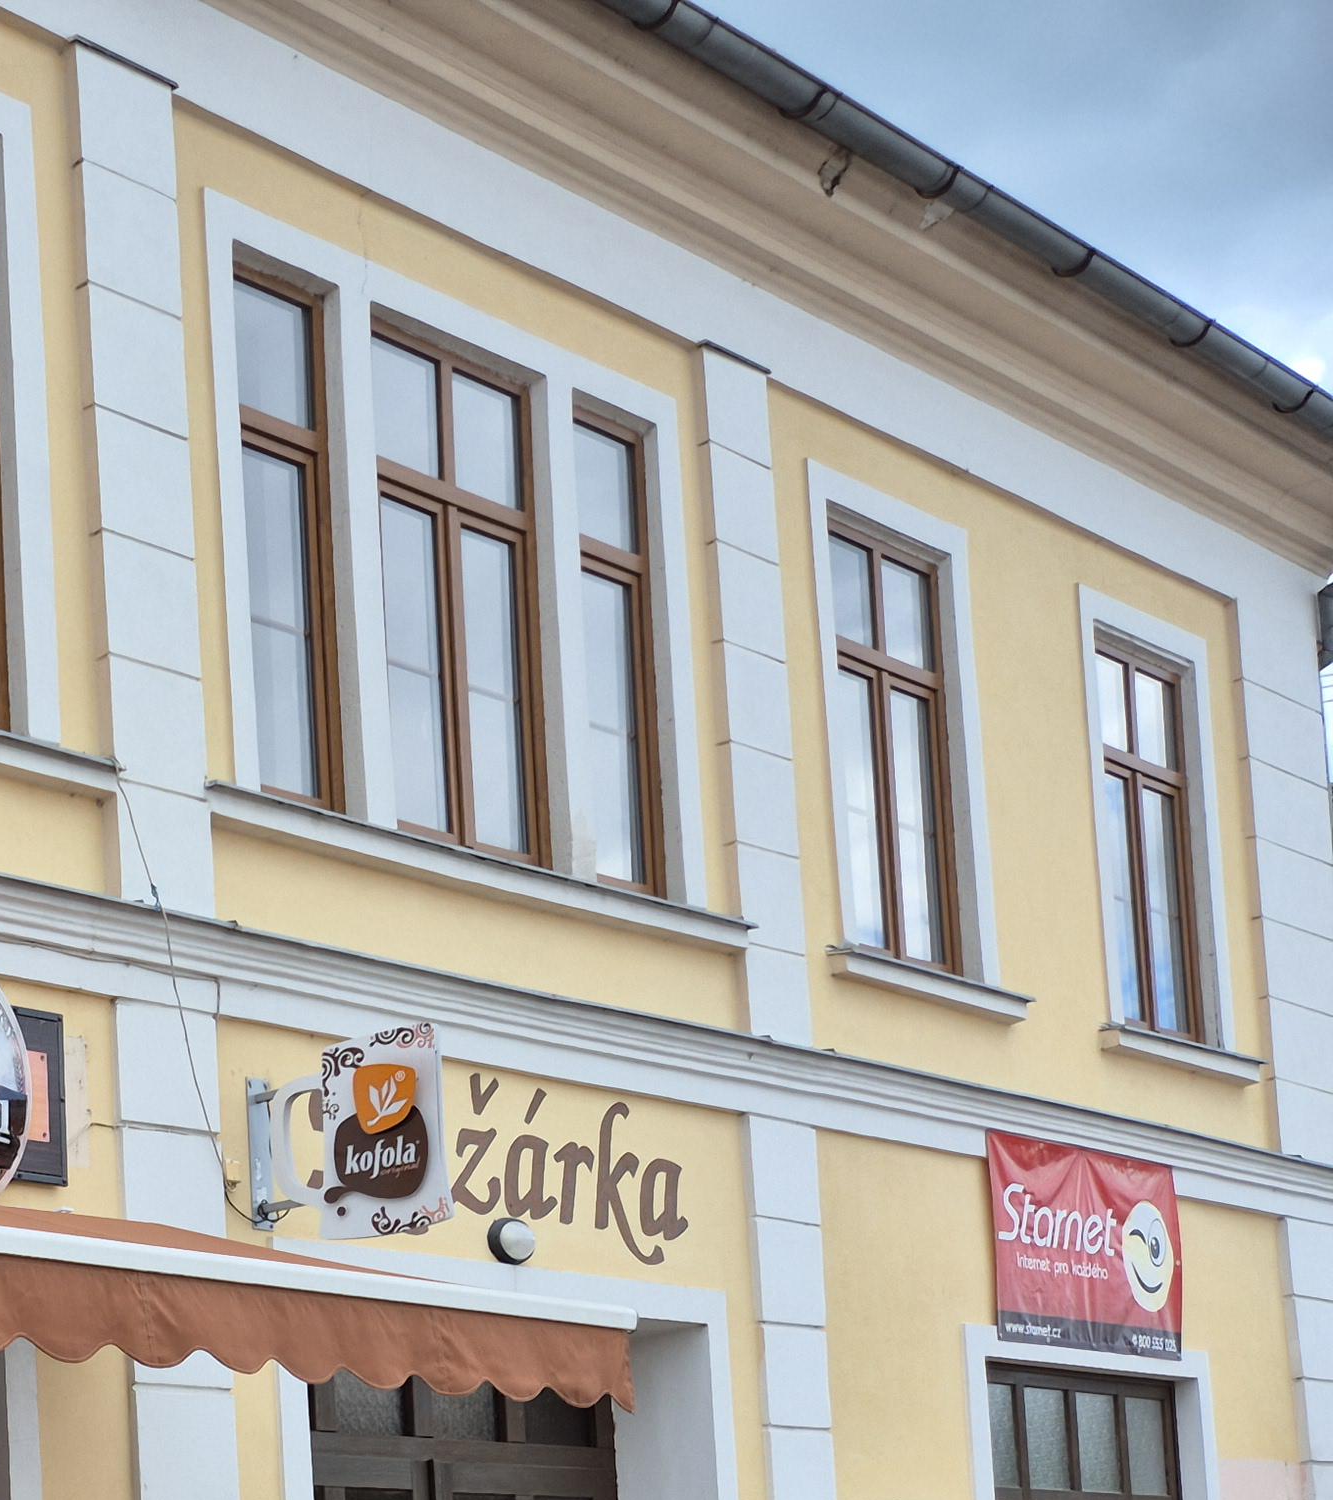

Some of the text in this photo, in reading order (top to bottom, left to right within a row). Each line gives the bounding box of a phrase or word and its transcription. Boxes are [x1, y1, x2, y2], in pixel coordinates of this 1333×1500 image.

[344, 1134, 417, 1180] kofola
[449, 1073, 688, 1266] žárka
[997, 1182, 1118, 1257] Starnet
[1015, 1251, 1109, 1281] Internet pro každého
[1004, 1320, 1062, 1340] www.starnet.cz
